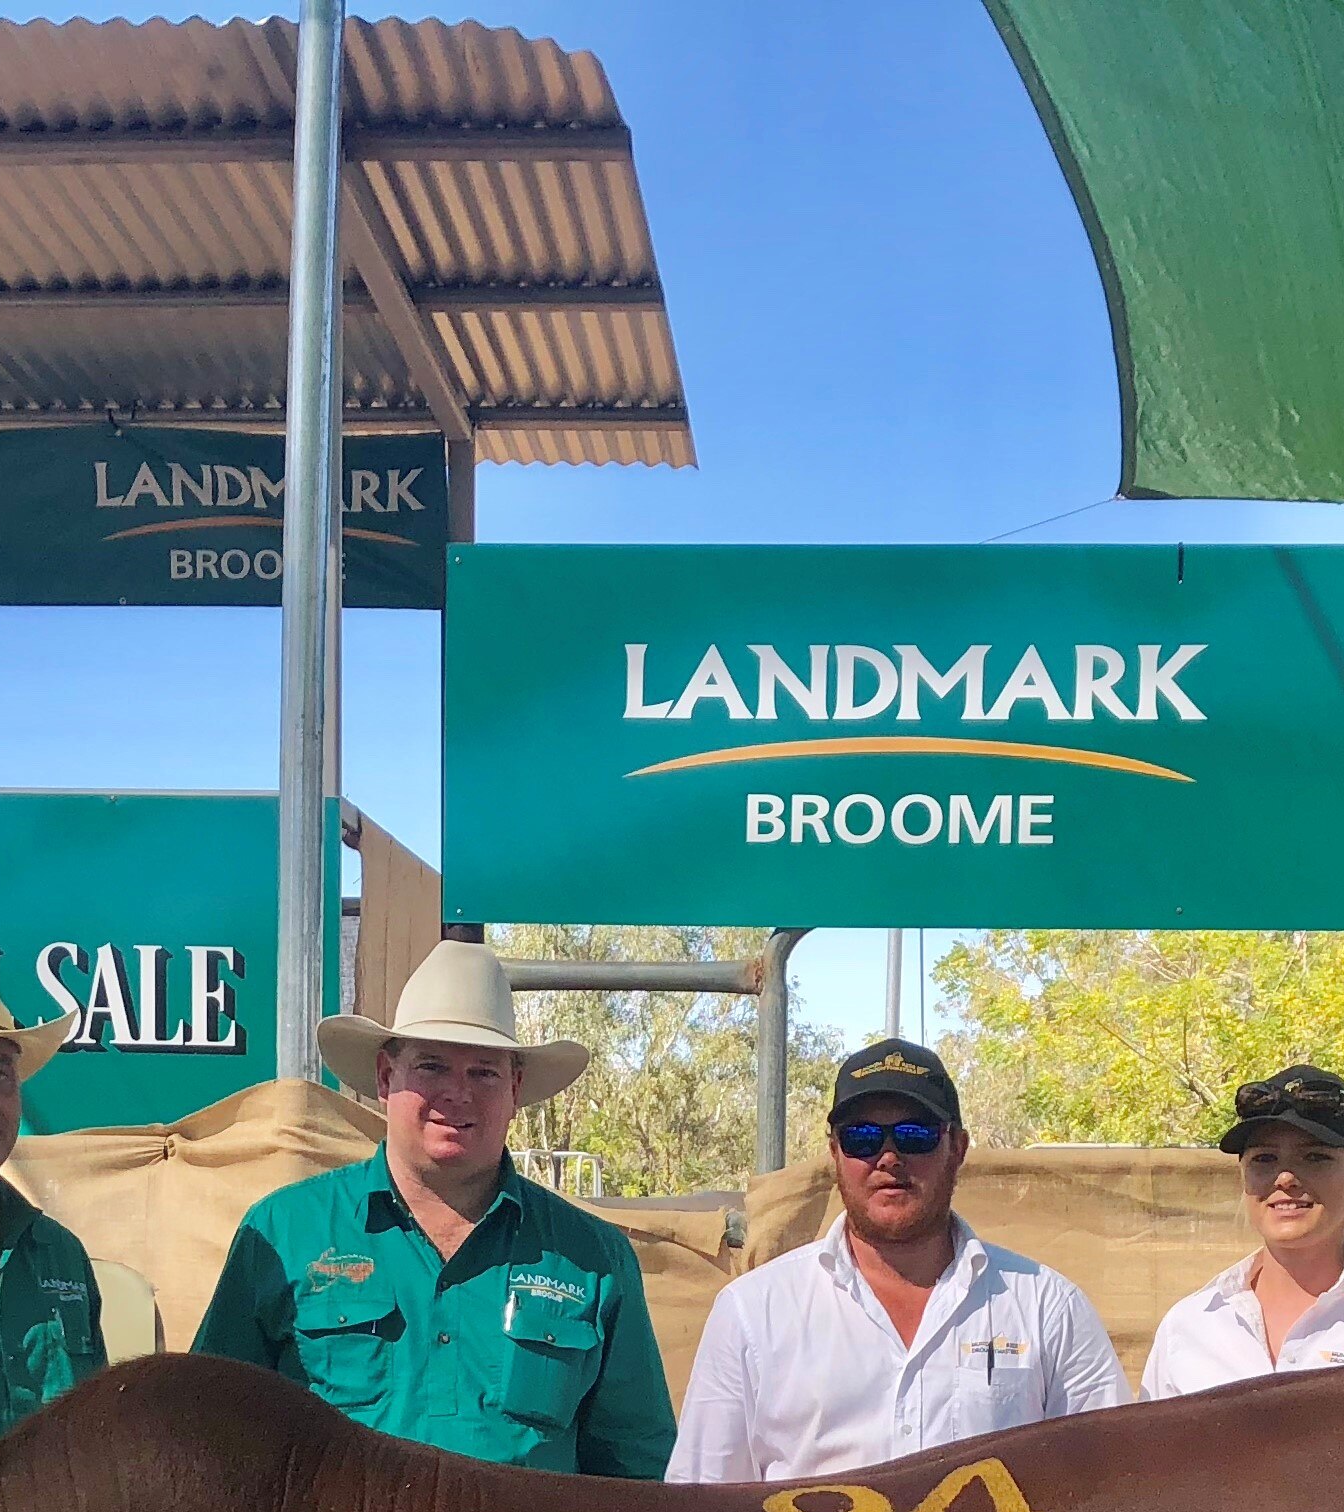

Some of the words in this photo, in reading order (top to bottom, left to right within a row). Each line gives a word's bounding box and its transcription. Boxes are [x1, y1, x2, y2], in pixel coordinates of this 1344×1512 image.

[93, 460, 427, 514] LANDMRK
[169, 548, 347, 580] BROO
[621, 642, 1210, 721] LANDMARK
[745, 792, 1055, 845] BROOME
[35, 940, 239, 1048] SALE
[509, 1272, 587, 1300] LANDMARK
